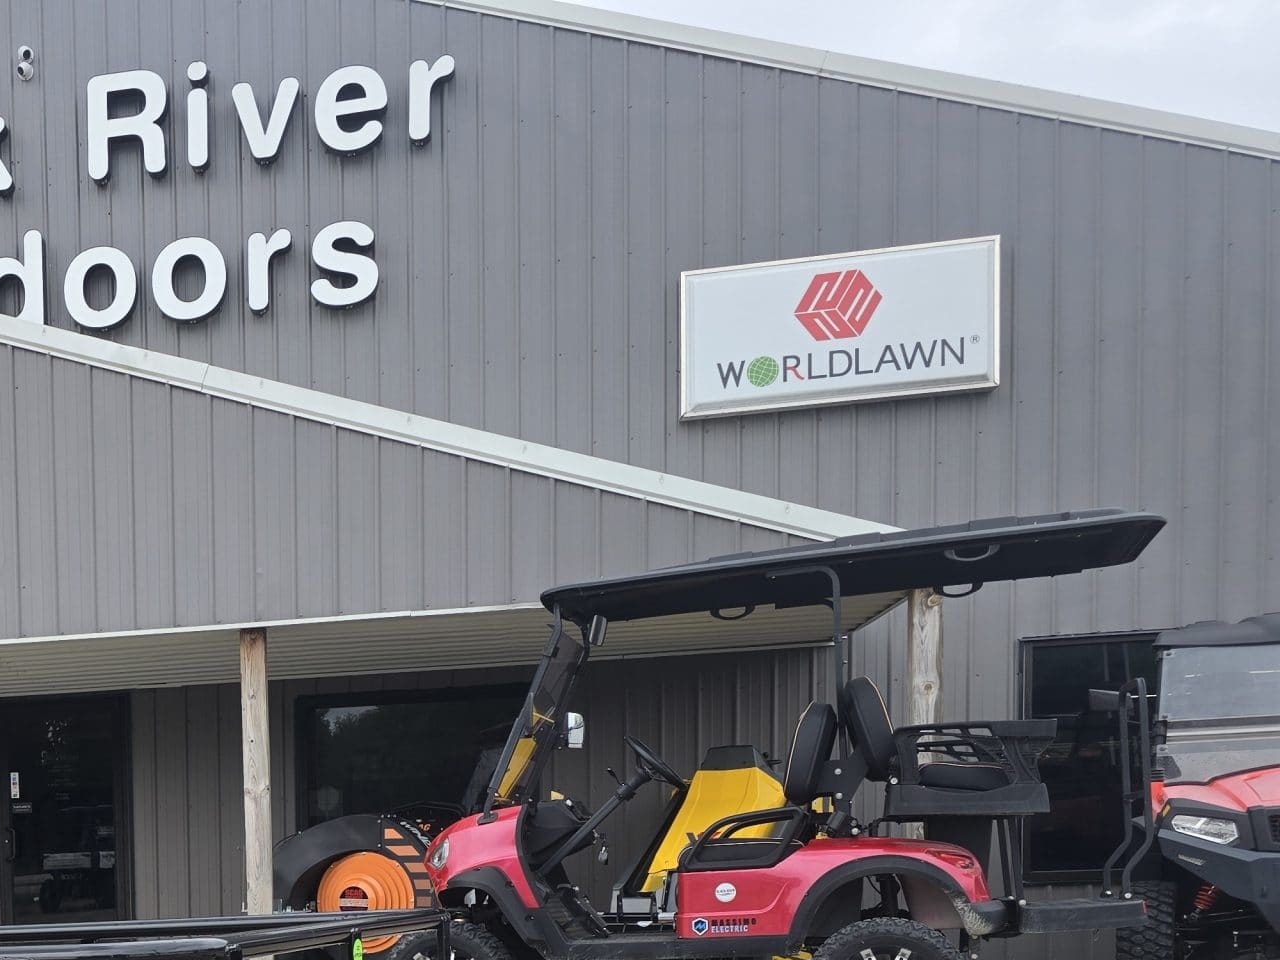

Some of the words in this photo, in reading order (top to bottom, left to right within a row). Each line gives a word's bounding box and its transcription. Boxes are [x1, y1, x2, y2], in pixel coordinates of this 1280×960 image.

[86, 54, 456, 186] River
[717, 336, 965, 389] WORLDLAWN
[711, 917, 757, 927] MASSIMO
[711, 924, 749, 934] ELECTRIC
